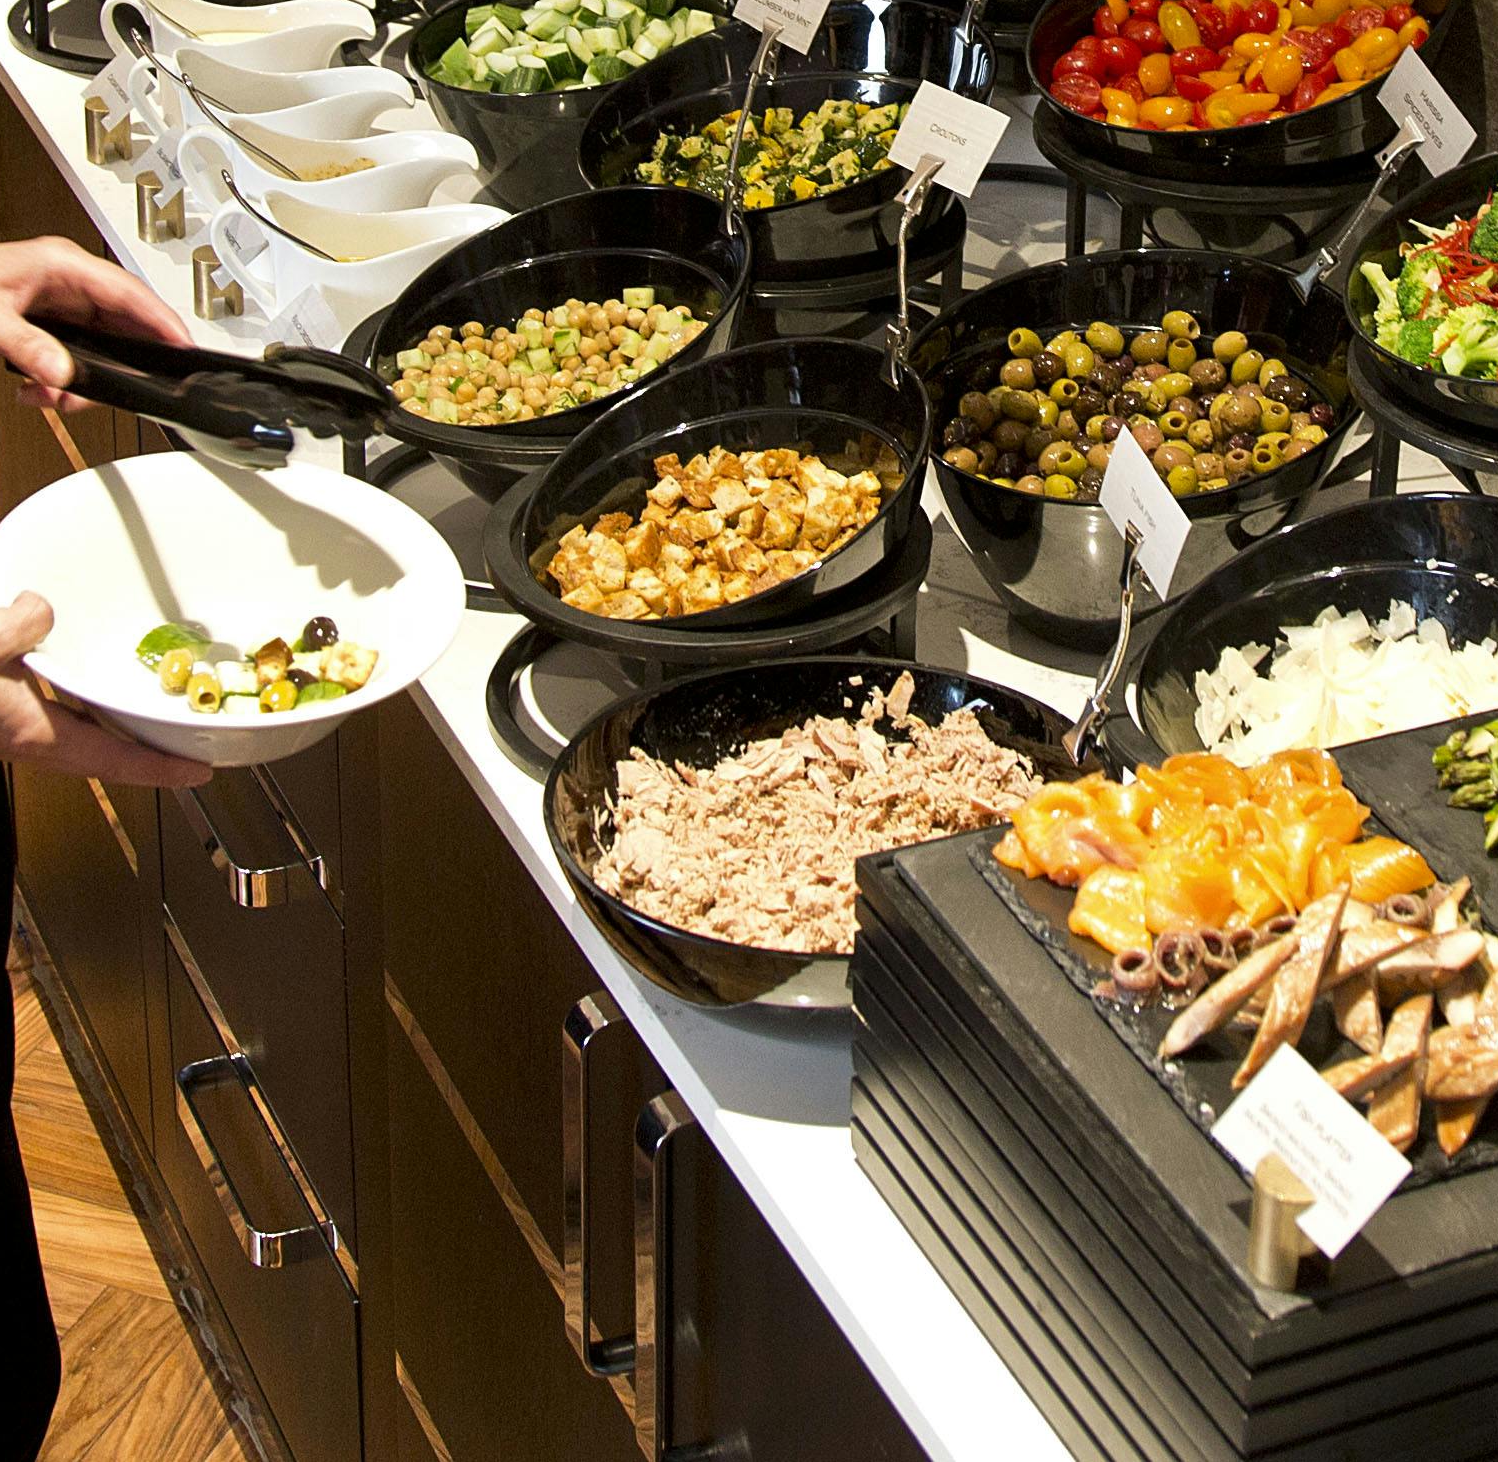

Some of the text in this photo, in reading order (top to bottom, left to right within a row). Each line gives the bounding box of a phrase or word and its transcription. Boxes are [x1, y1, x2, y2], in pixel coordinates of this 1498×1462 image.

[782, 9, 796, 20] AND
[796, 13, 812, 27] MINT
[1403, 93, 1443, 149] SPICED OLIVES
[1420, 90, 1444, 124] HARISSA
[929, 123, 967, 146] CROUTONS
[1315, 1122, 1353, 1163] PLATTER
